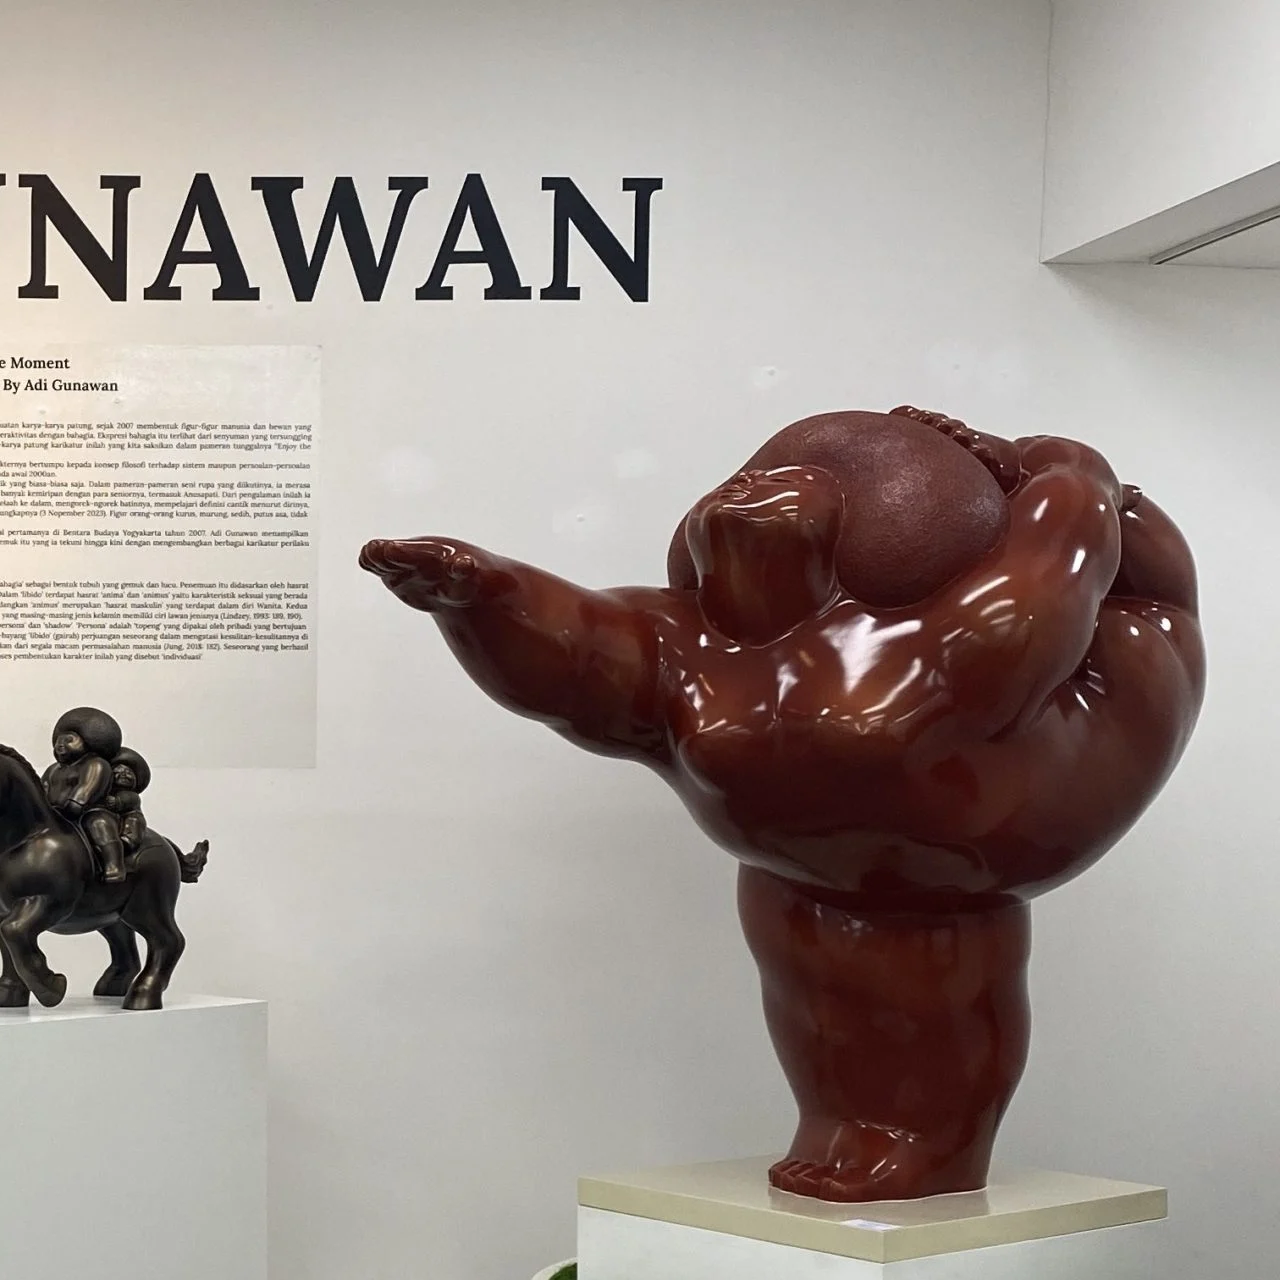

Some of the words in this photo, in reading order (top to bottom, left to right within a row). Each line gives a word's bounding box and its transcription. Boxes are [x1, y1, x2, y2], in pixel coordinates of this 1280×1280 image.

[10, 355, 70, 371] Moment
[3, 378, 21, 396] By
[24, 378, 48, 393] Adi
[51, 379, 119, 394] Gunawan
[21, 421, 65, 431] karya-karya
[66, 421, 94, 431] patung,
[96, 422, 114, 431] sejak
[136, 422, 179, 430] membentuk
[181, 422, 218, 432] figur-figur
[220, 422, 251, 430] manusia
[268, 422, 292, 430] hewan
[294, 424, 312, 432] yang
[38, 431, 65, 441] dengan
[23, 440, 49, 450] patung
[48, 509, 85, 519] Nopember
[7, 528, 50, 538] pertamanya
[62, 528, 91, 536] Bentara
[93, 528, 120, 538] Budaya
[122, 529, 162, 539] Yogyakarta
[185, 601, 216, 611] terdapat
[13, 652, 62, 662] pembentukan
[62, 652, 93, 660] karakter
[94, 652, 114, 660] inilah
[115, 654, 133, 662] yang
[133, 652, 160, 660] disebut
